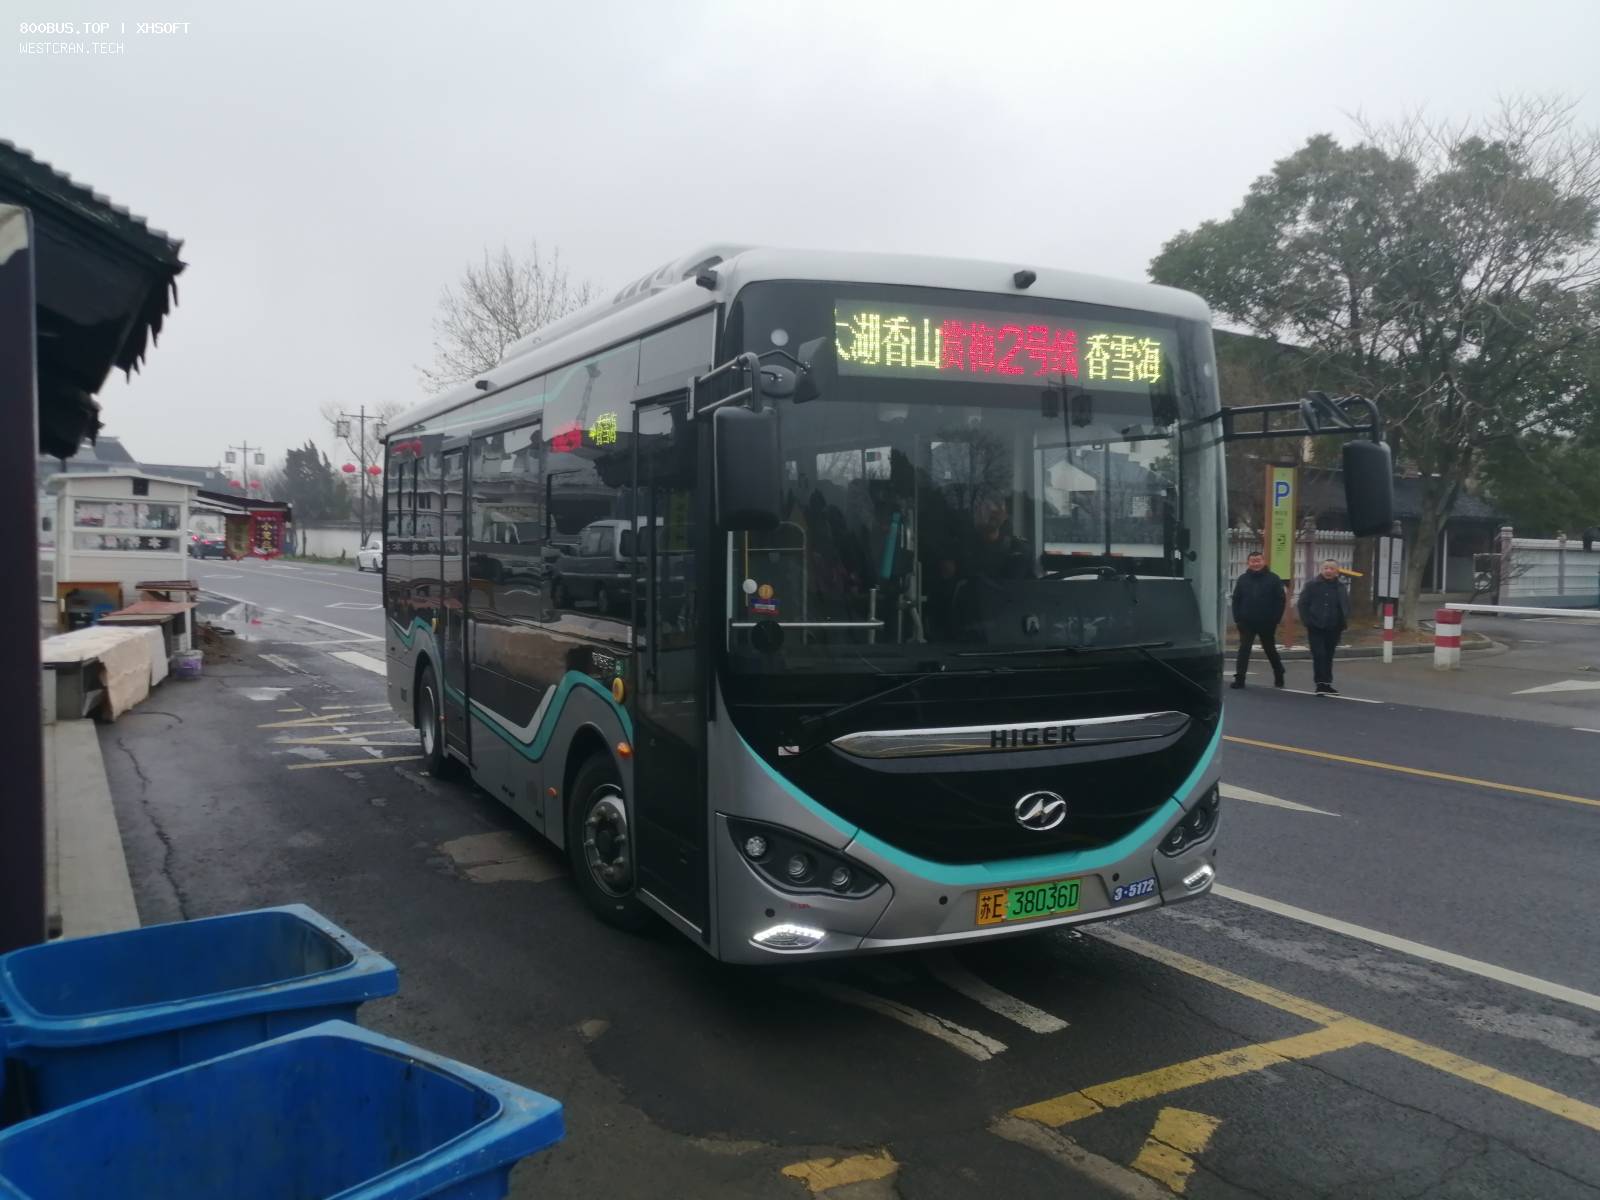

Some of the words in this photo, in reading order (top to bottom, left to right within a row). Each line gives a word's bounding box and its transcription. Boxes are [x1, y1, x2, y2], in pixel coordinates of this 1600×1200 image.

[1085, 333, 1162, 383] 香雪海
[1275, 481, 1290, 506] P
[990, 725, 1076, 748] HIGER
